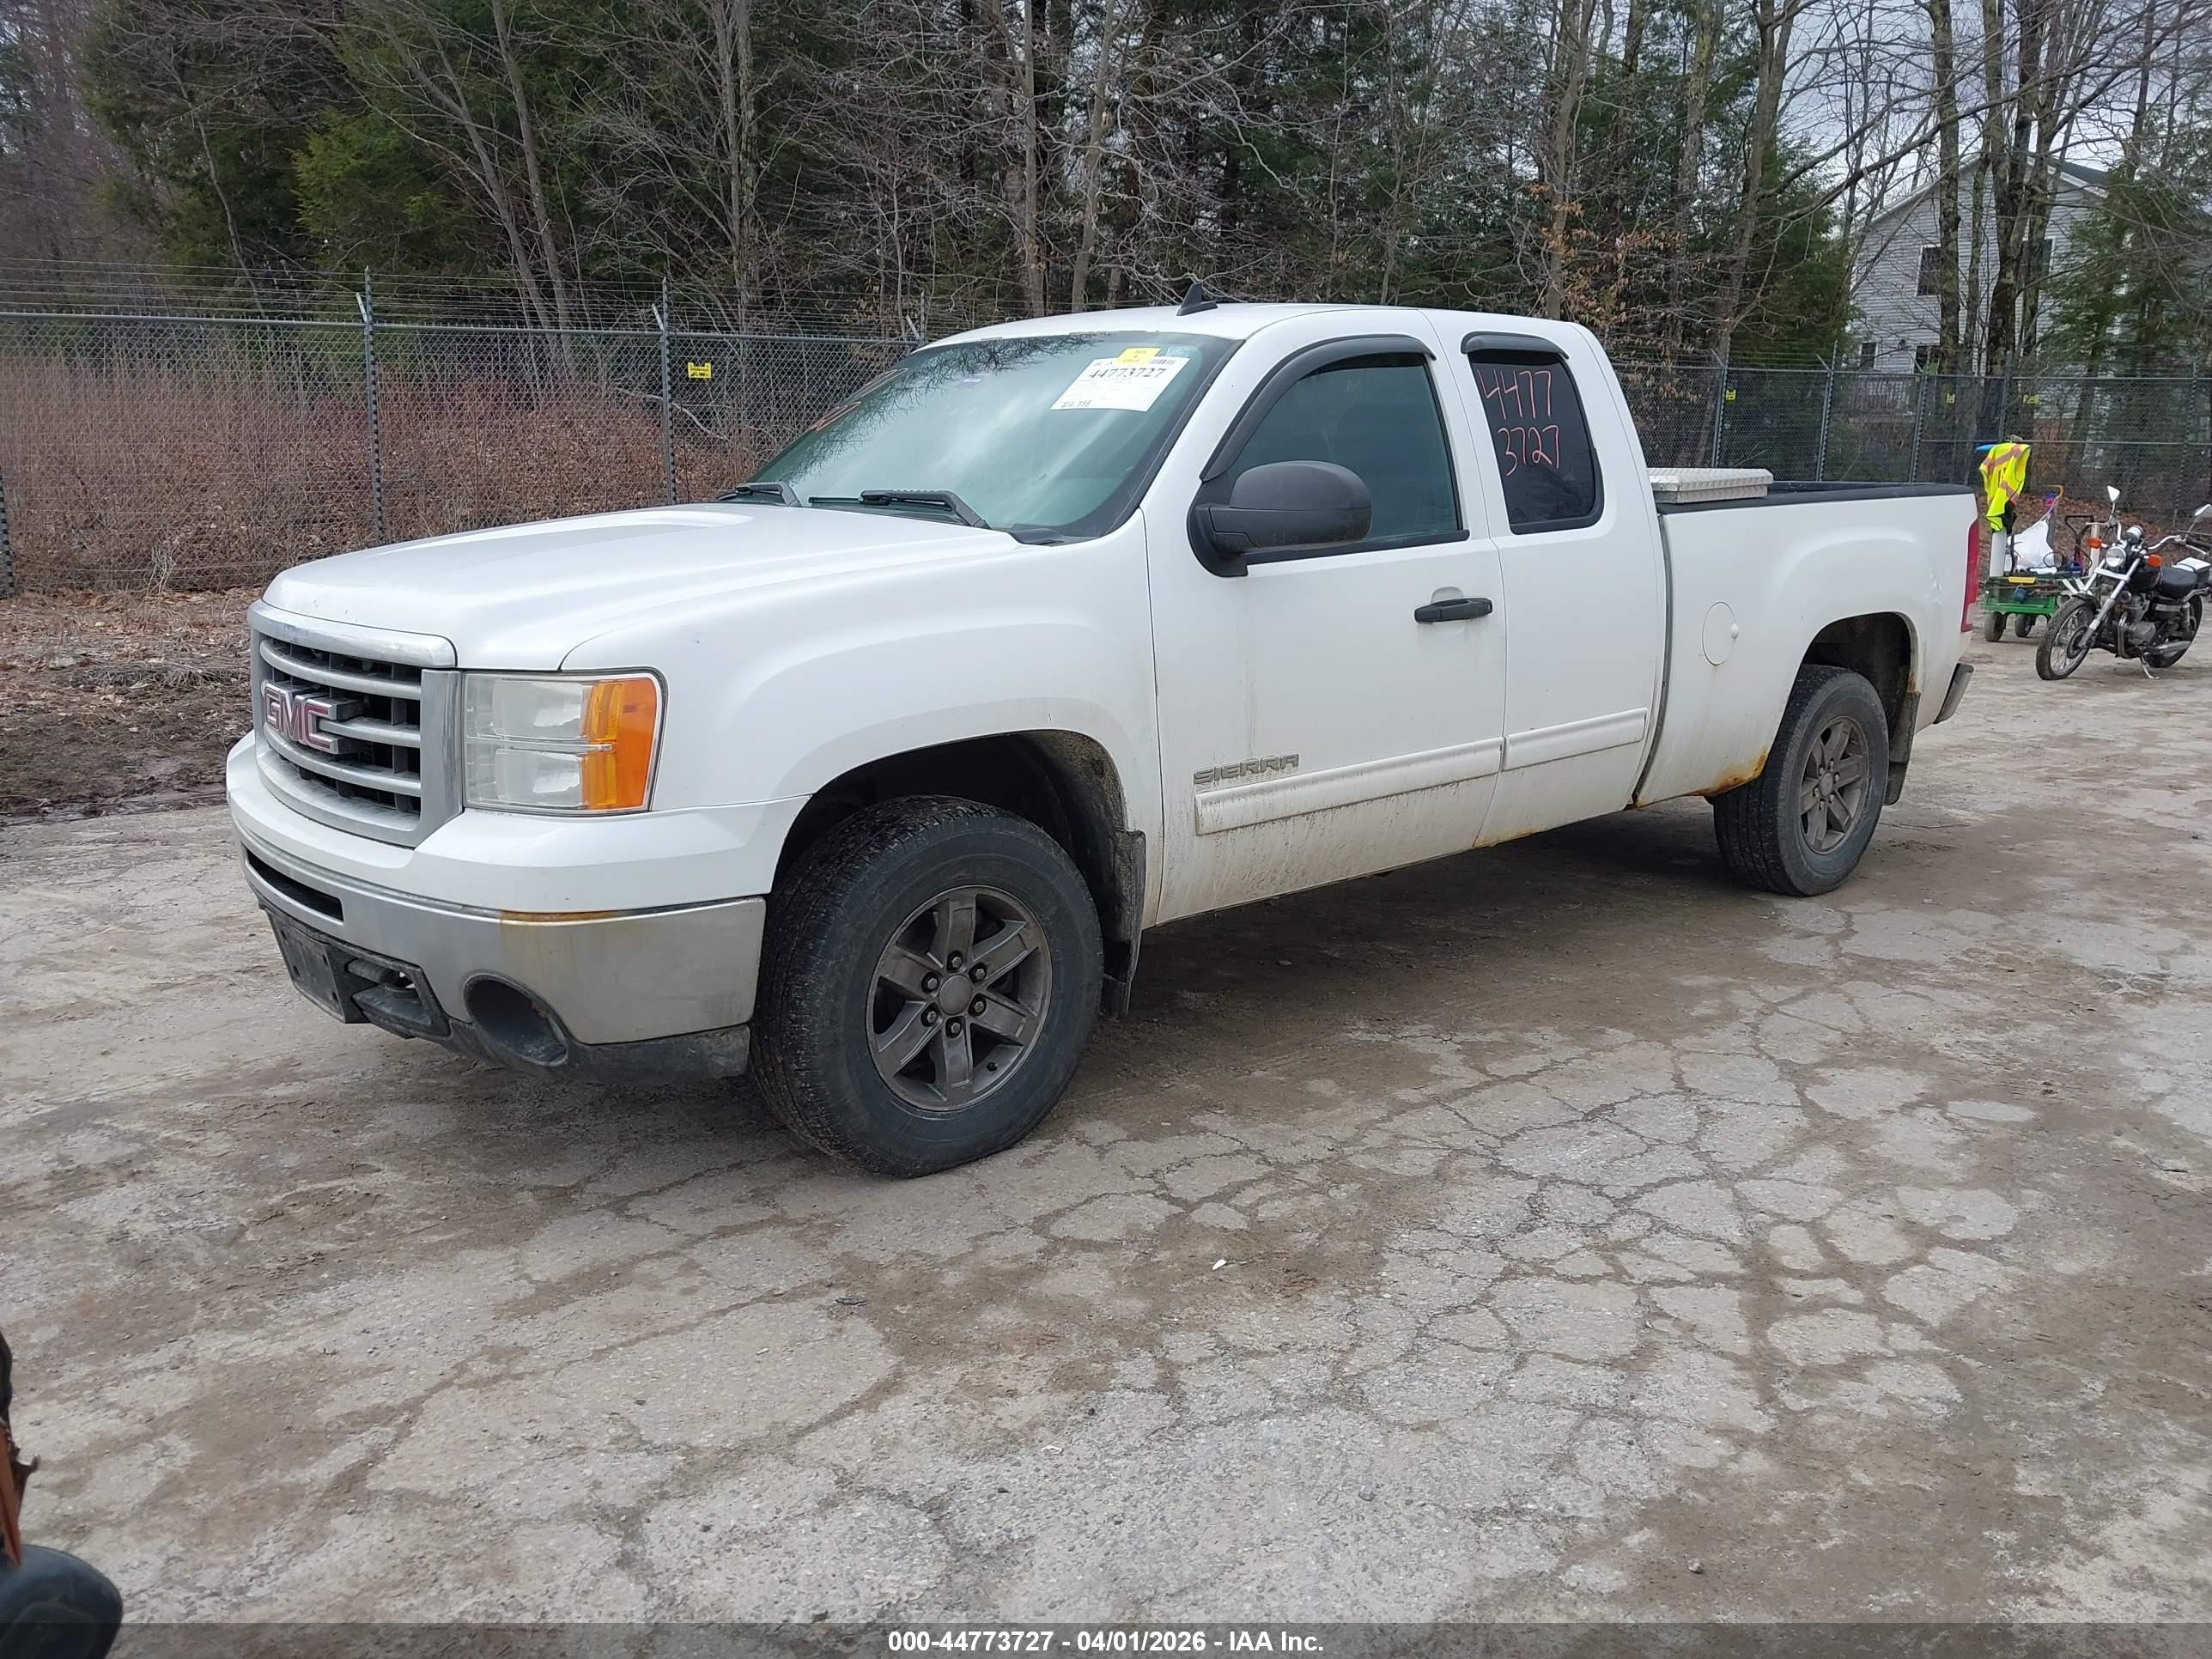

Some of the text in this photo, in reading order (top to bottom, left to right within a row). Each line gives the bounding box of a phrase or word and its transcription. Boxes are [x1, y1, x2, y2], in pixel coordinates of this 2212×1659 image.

[1088, 368, 1168, 379] 44773727
[1476, 368, 1552, 420] 4477
[1497, 424, 1559, 477] 3727
[264, 683, 339, 755] GMC
[1193, 753, 1299, 785] SIERRA
